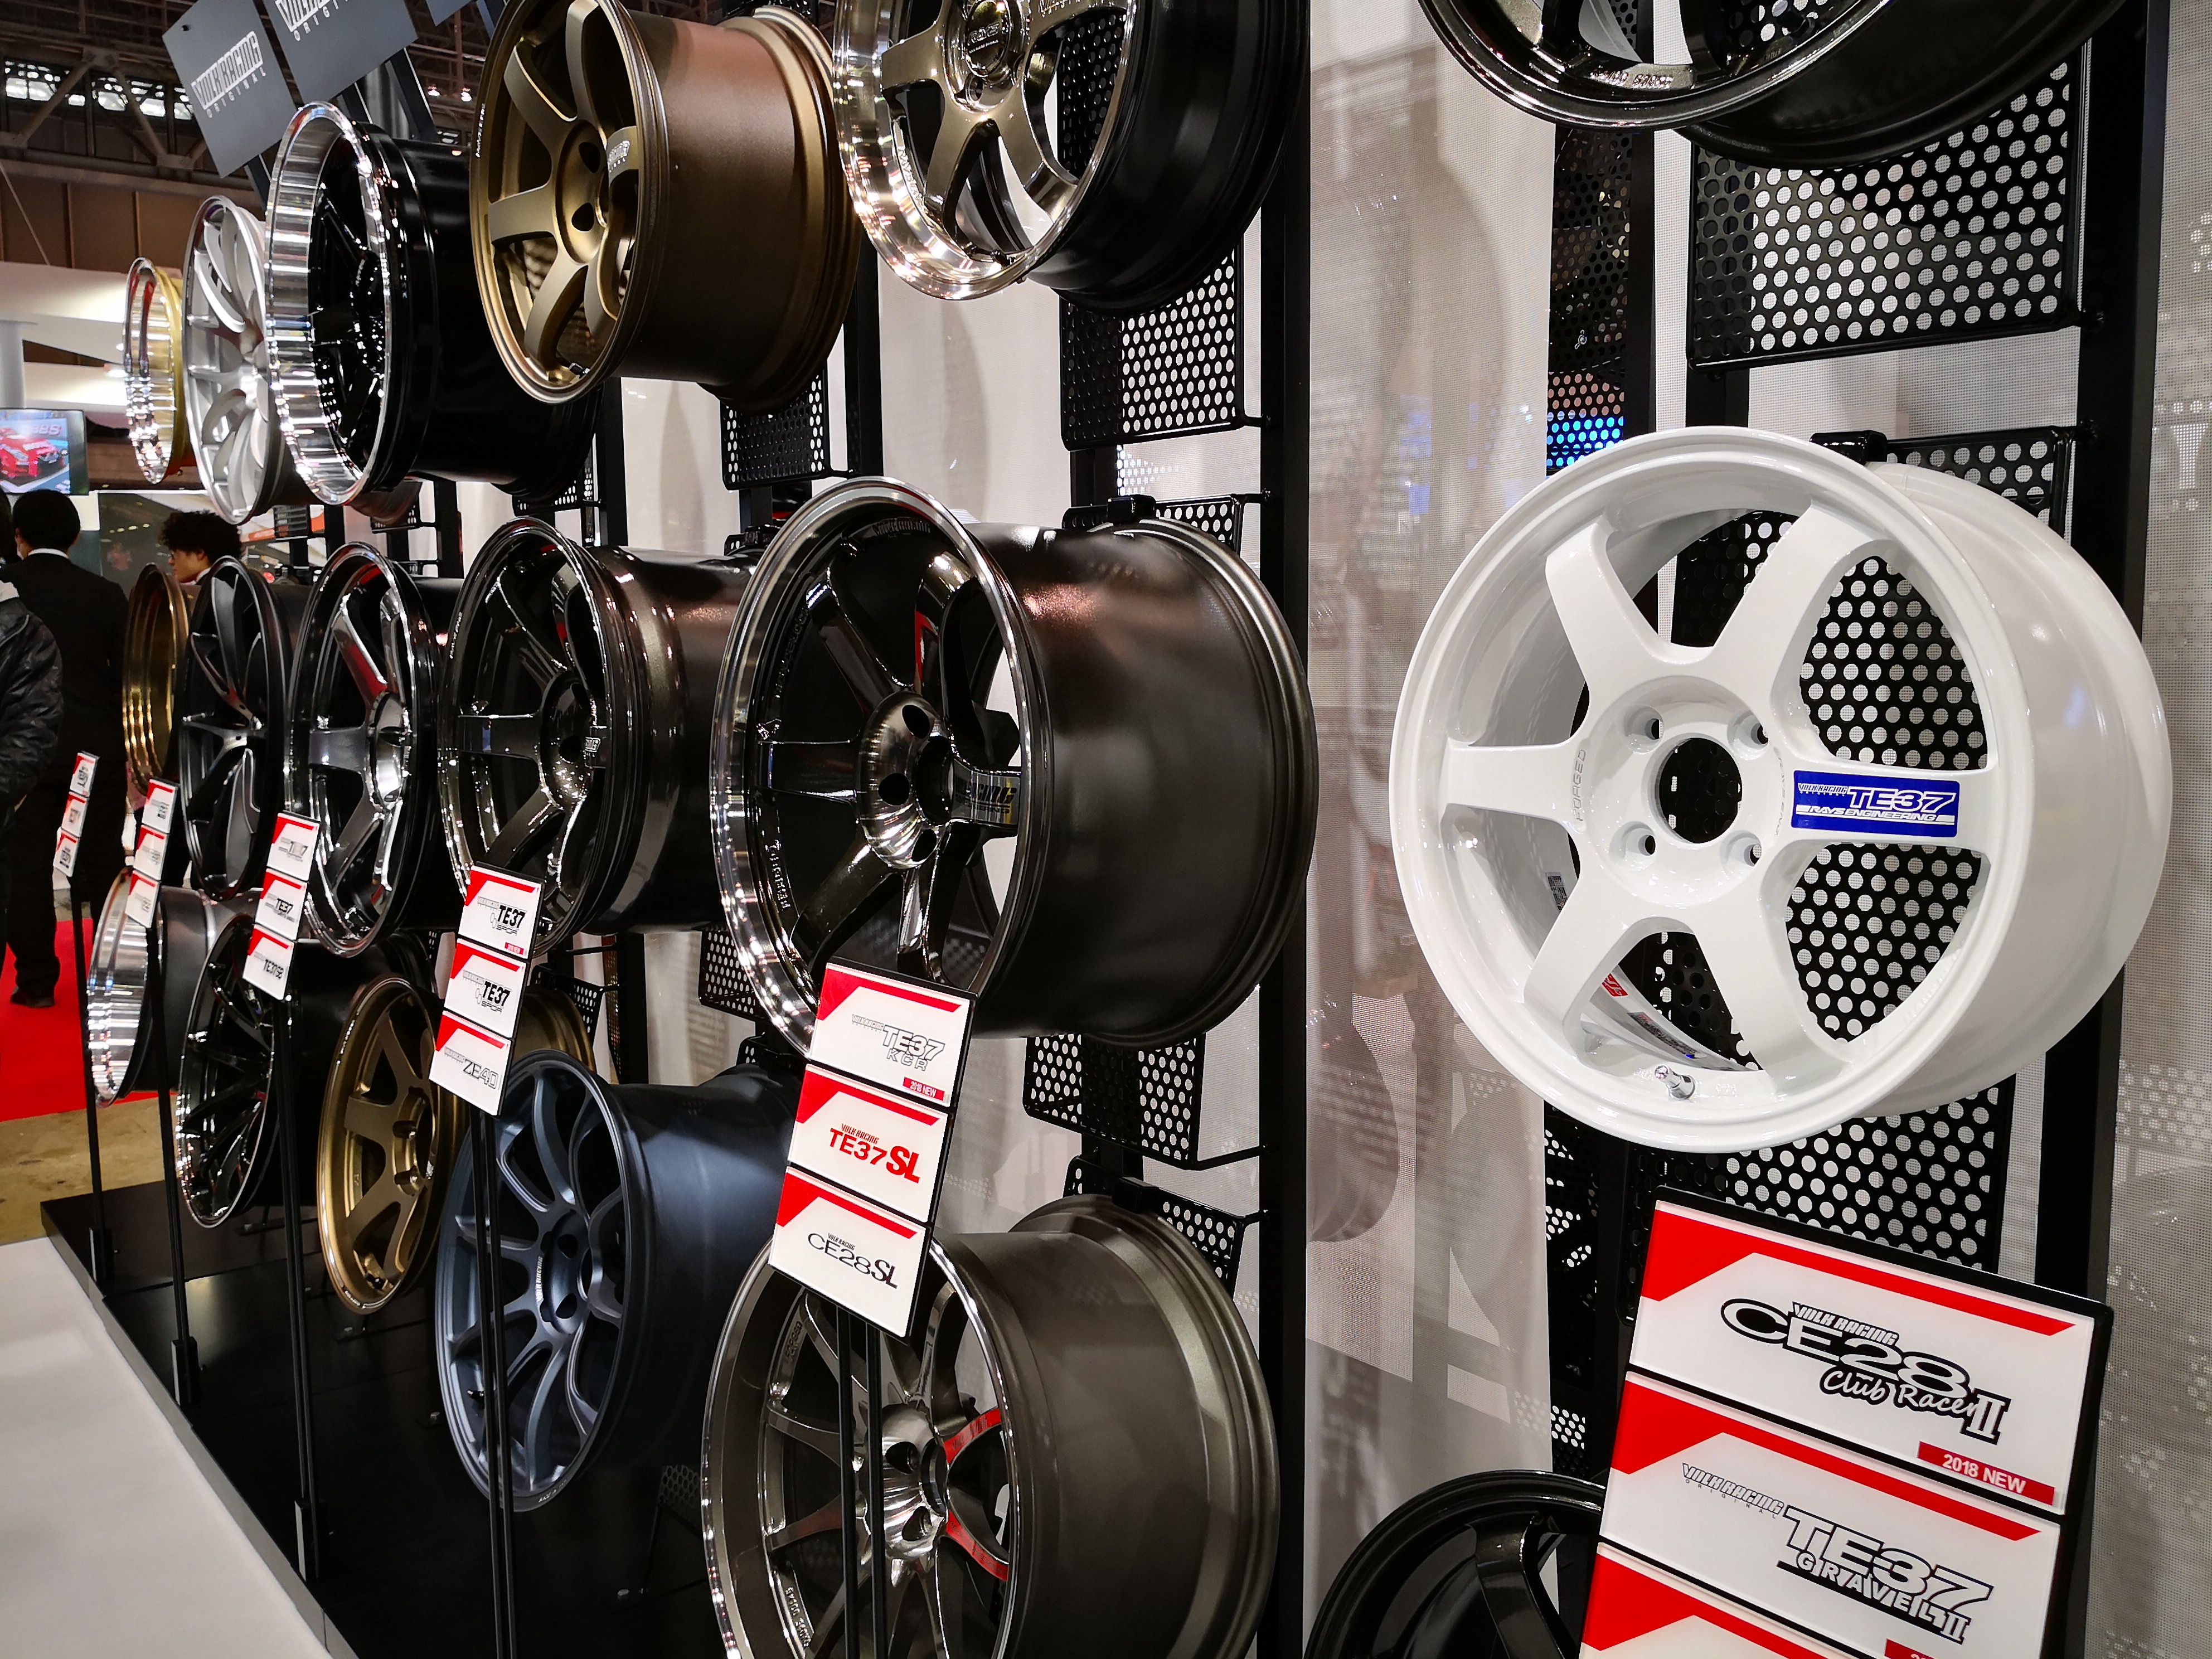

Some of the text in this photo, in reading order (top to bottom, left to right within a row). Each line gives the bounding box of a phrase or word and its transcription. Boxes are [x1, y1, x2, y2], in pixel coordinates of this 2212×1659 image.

[191, 31, 264, 110] VOLK RACING
[1572, 749, 1587, 821] FORGED
[1847, 786, 1957, 813] TE37
[1808, 804, 1937, 822] RAYS ENGINEERING
[498, 904, 527, 929] TE37
[482, 980, 511, 1007] TE37
[882, 1024, 946, 1061] TE37
[886, 1047, 929, 1072] KCR
[463, 1058, 499, 1090] ZE40
[921, 1084, 937, 1098] NEW
[841, 1123, 880, 1144] VOLK RACING
[1791, 1301, 1899, 1347] VOLK RACING
[1720, 1298, 1971, 1398] CE28
[1818, 1365, 1889, 1405] Club
[1682, 1462, 1785, 1515] VOLK RACING
[1942, 1453, 2027, 1495] 2018 NEW
[1685, 1478, 1777, 1519] ORIGINAL
[1783, 1504, 1995, 1612] TE37
